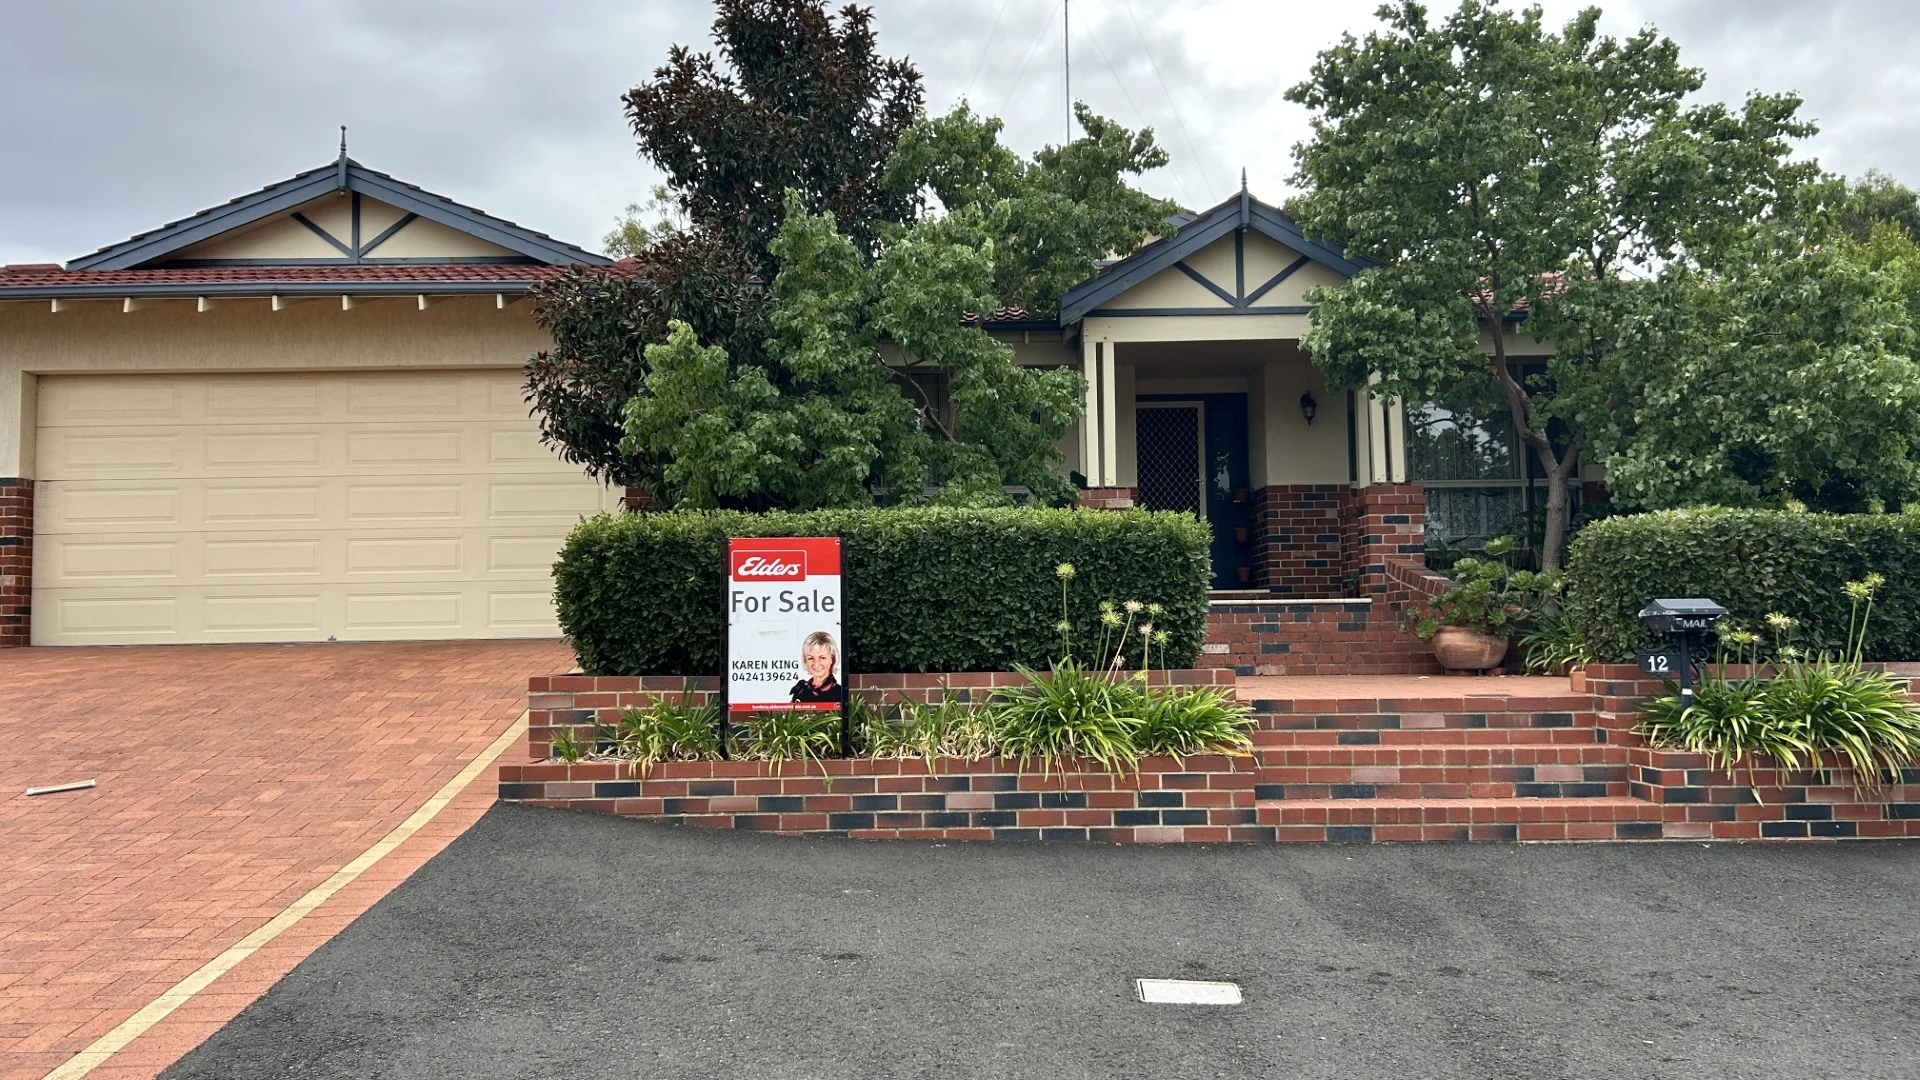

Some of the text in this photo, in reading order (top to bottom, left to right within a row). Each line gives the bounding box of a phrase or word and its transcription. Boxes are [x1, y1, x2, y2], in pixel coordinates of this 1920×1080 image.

[738, 557, 801, 576] Elders
[732, 590, 835, 613] For Sale
[1682, 619, 1708, 628] MAIL
[732, 660, 799, 670] KAREN KING
[1648, 656, 1668, 671] 12
[732, 672, 799, 682] 0424139624
